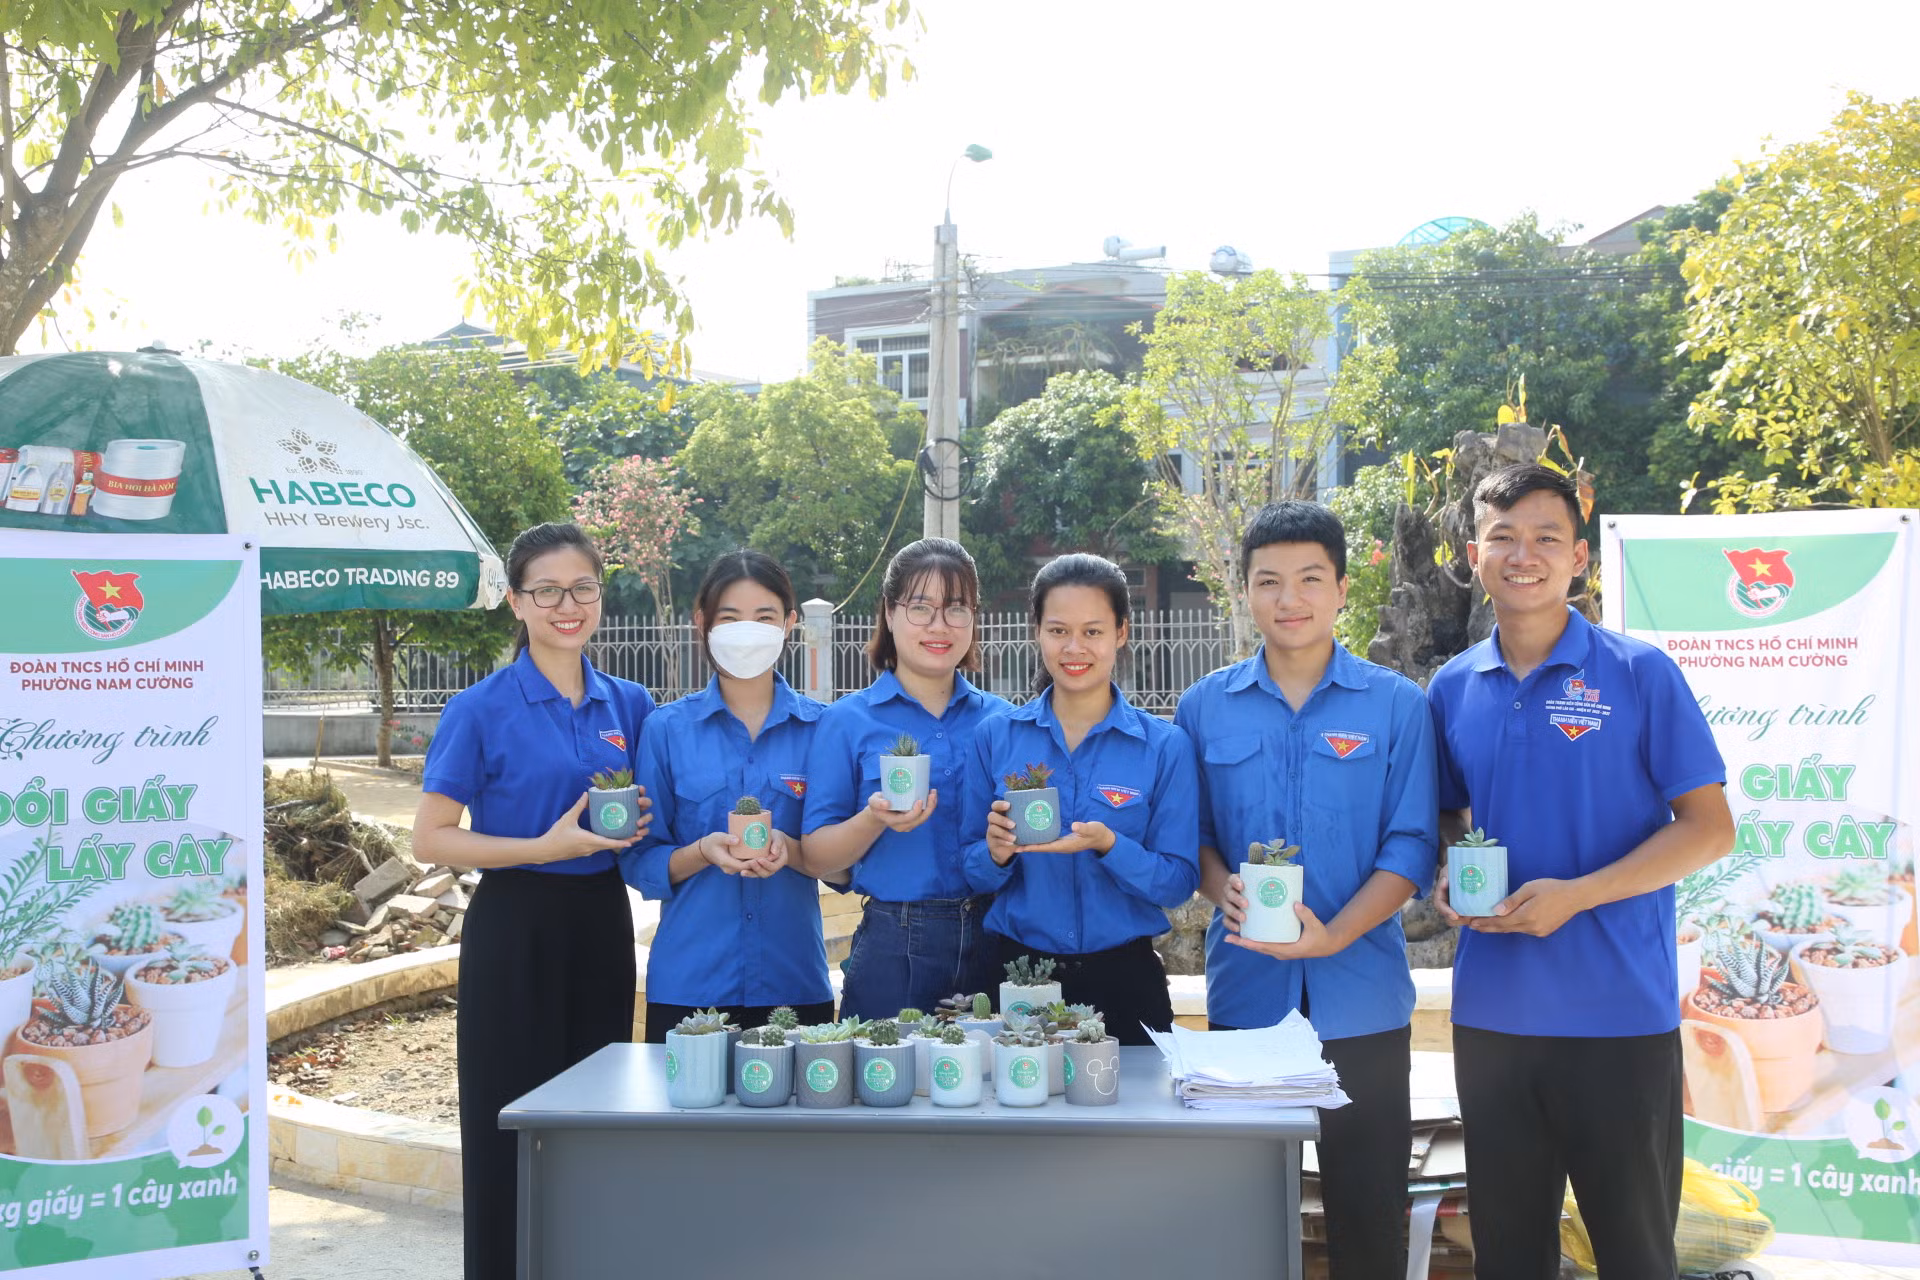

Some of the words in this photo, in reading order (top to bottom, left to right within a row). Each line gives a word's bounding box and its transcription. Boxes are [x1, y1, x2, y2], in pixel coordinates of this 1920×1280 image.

[248, 476, 416, 508] HABECO
[263, 511, 309, 527] HHY
[313, 512, 391, 533] Brewery
[396, 514, 430, 530] Jsc.
[344, 567, 431, 586] TRADING
[434, 570, 460, 589] 89
[1667, 636, 1711, 651] ĐOÀN
[1715, 639, 1755, 651] TNCS
[1786, 635, 1813, 650] CHÍ
[1817, 637, 1858, 650] MINH
[10, 658, 57, 674] ĐOÀN
[61, 661, 102, 673] TNCS
[106, 657, 130, 673] HỒ
[133, 658, 161, 673] CHÍ
[164, 660, 204, 672] MINH
[1679, 655, 1745, 668] PHƯỜNG
[1749, 656, 1784, 668] NAM
[21, 677, 92, 691] PHƯỜNG
[96, 678, 132, 690] NAM
[135, 676, 194, 690] CƯỜNG
[1788, 694, 1876, 726] trình
[133, 715, 219, 748] trình
[1739, 753, 1856, 802] GIẤY
[82, 774, 198, 825] GIẤY
[1727, 810, 1795, 859] ẤY
[1802, 814, 1898, 860] CÂY
[46, 833, 136, 883] LẤY
[143, 833, 233, 879] CÂY
[1791, 1162, 1802, 1188] 1
[1807, 1163, 1854, 1197] cây
[27, 1184, 85, 1226] giấy
[111, 1182, 123, 1208] 1
[127, 1178, 173, 1209] cây
[177, 1169, 238, 1201] xanh
